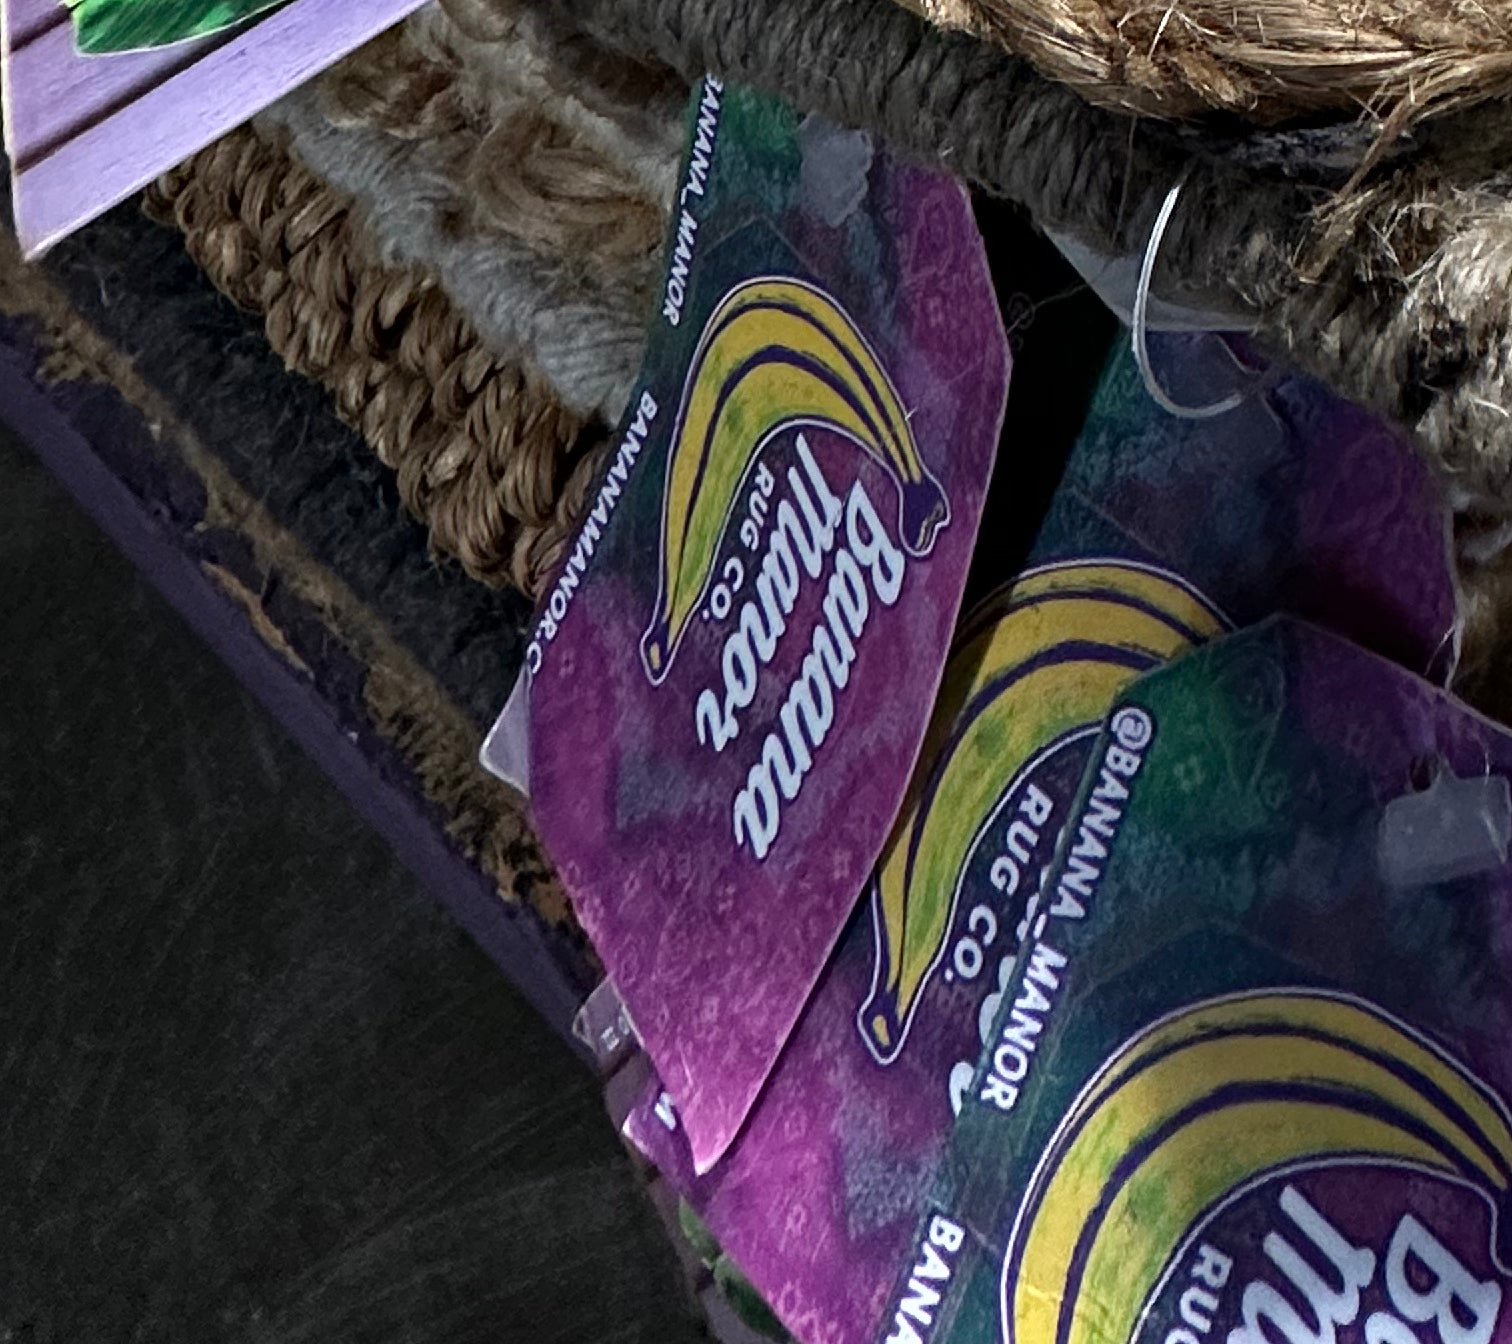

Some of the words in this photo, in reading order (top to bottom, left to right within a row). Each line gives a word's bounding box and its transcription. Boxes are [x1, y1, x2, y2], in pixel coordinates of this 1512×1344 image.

[738, 460, 776, 551] RUG
[696, 431, 841, 753] Manor
[702, 556, 745, 620] CO.
[734, 477, 906, 859] Banana
[989, 784, 1054, 896] RUG
[945, 904, 998, 981] CO.
